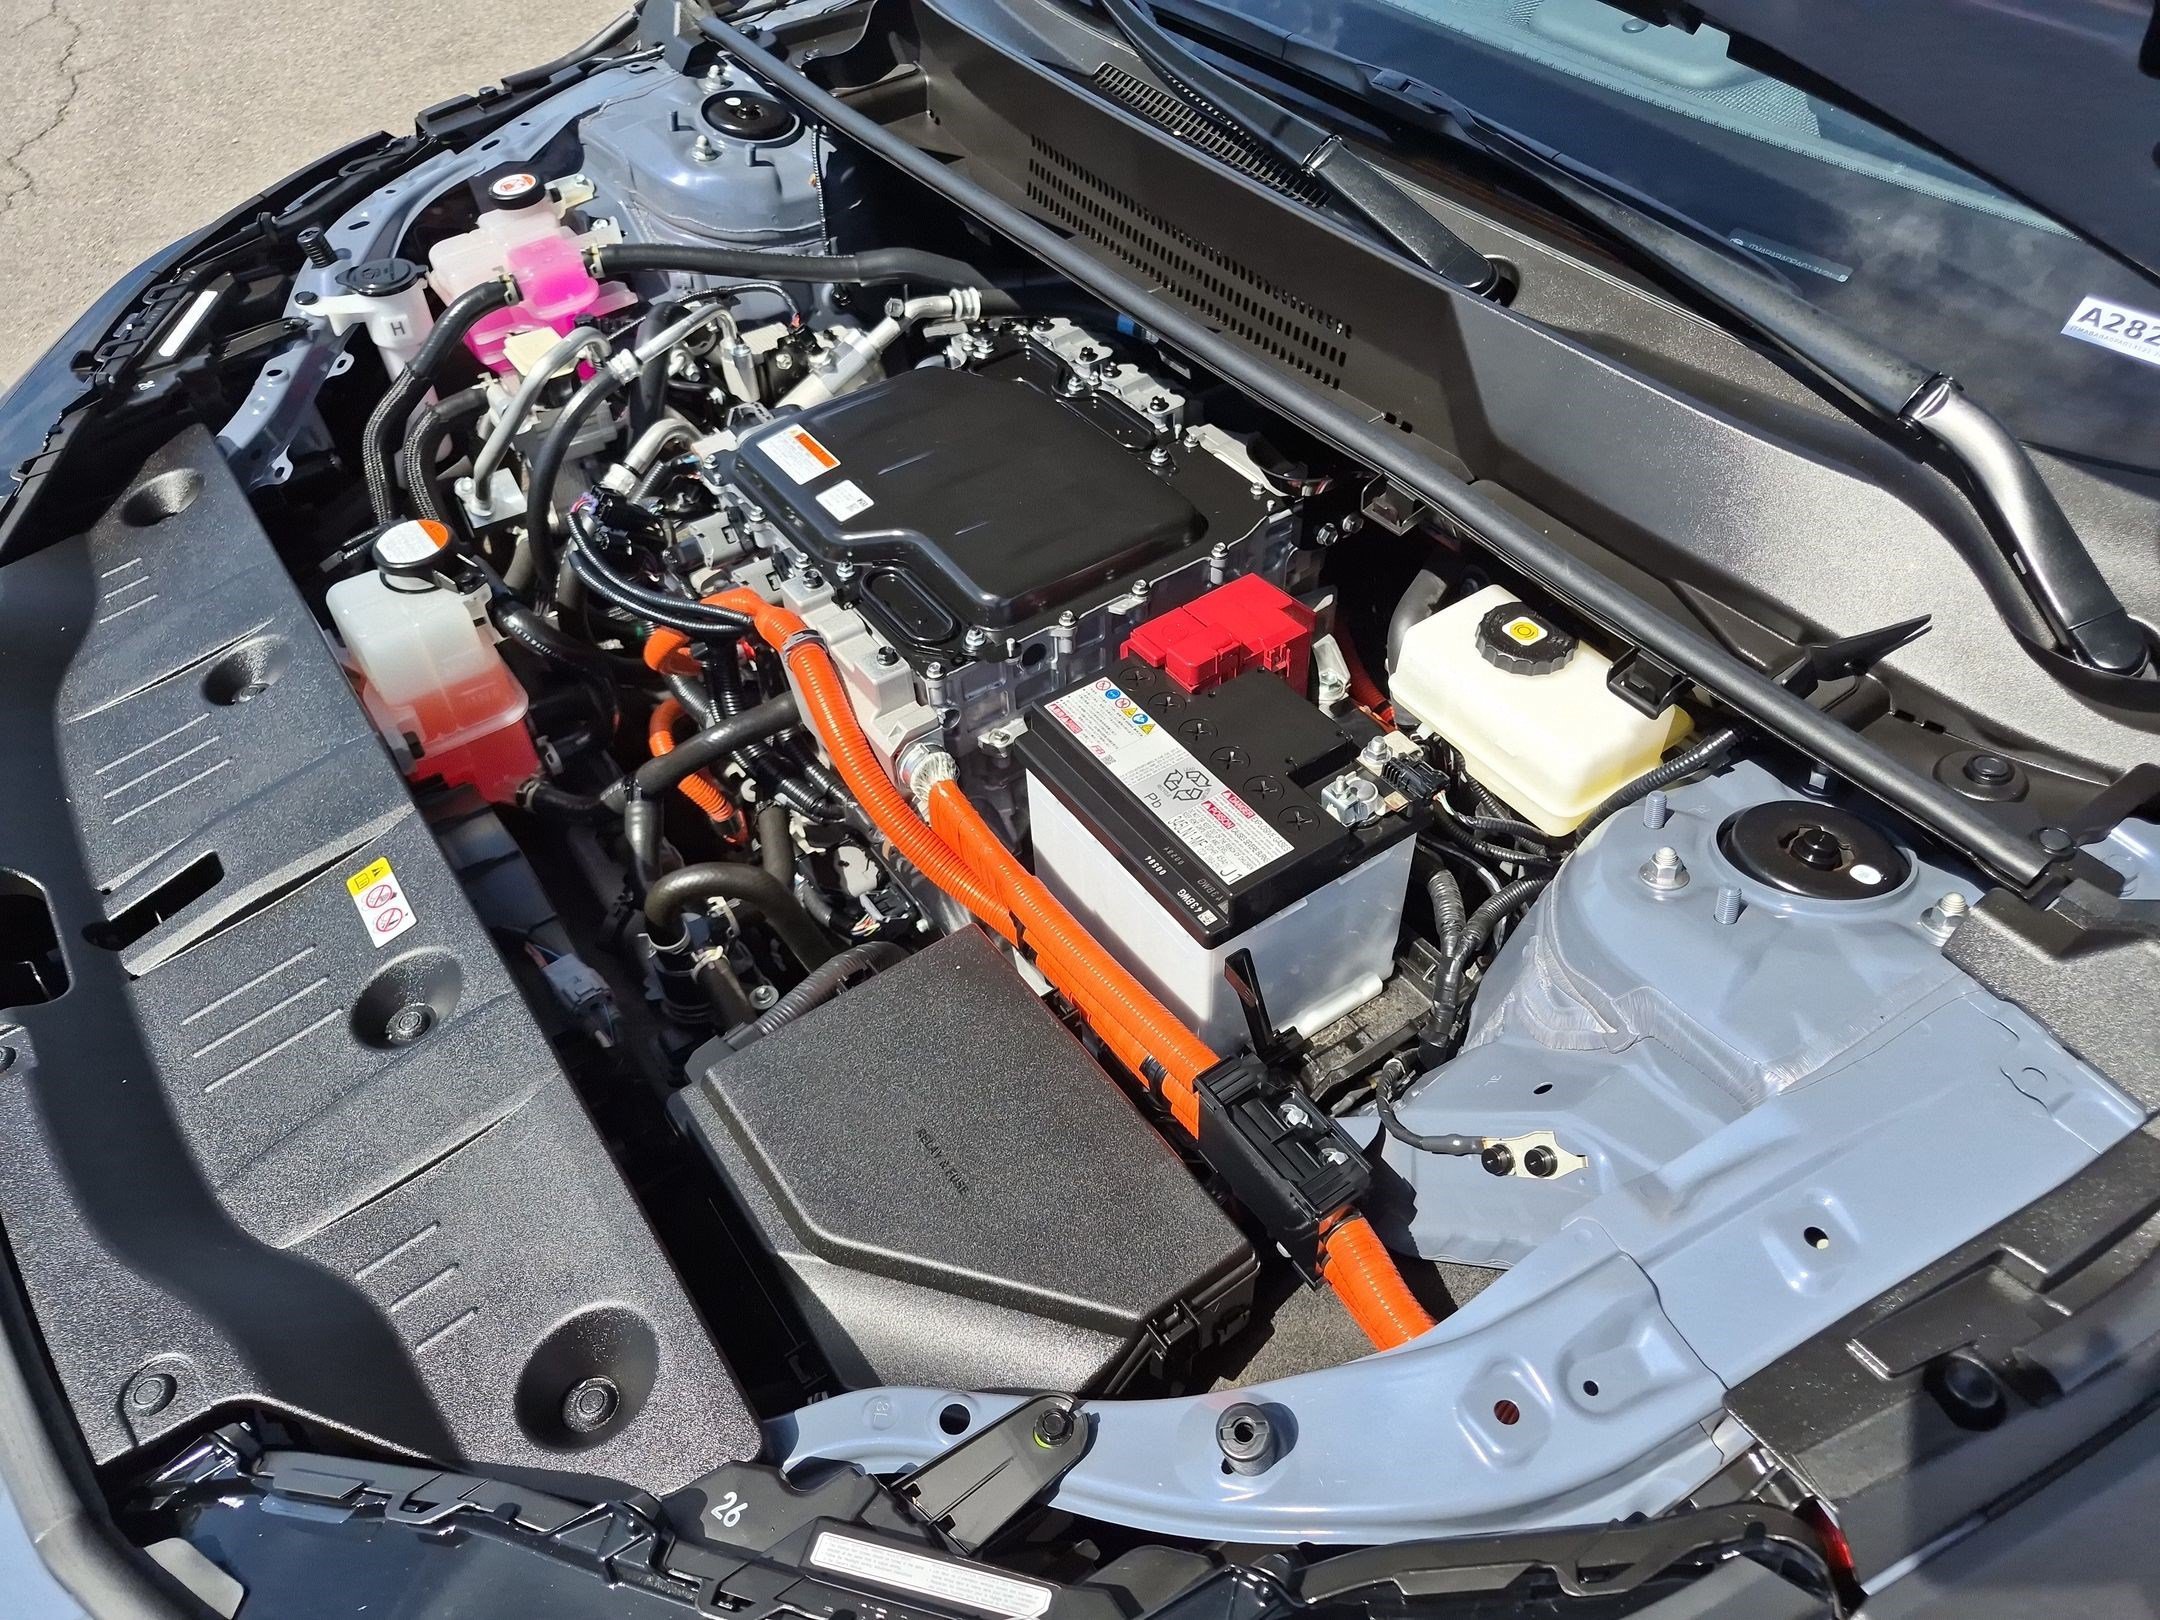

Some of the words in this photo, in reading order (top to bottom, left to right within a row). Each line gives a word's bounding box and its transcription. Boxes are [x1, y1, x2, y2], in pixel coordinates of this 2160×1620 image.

[390, 321, 406, 336] H
[1144, 792, 1162, 808] Pb
[1208, 806, 1235, 829] POISON
[1228, 795, 1253, 819] DANGER
[1273, 837, 1290, 852] GASES
[1220, 869, 1243, 883] J1
[1177, 889, 1203, 913] 43BWG
[915, 1128, 942, 1159] RELAY
[945, 1167, 969, 1195] FUSE
[710, 1491, 749, 1527] 26
